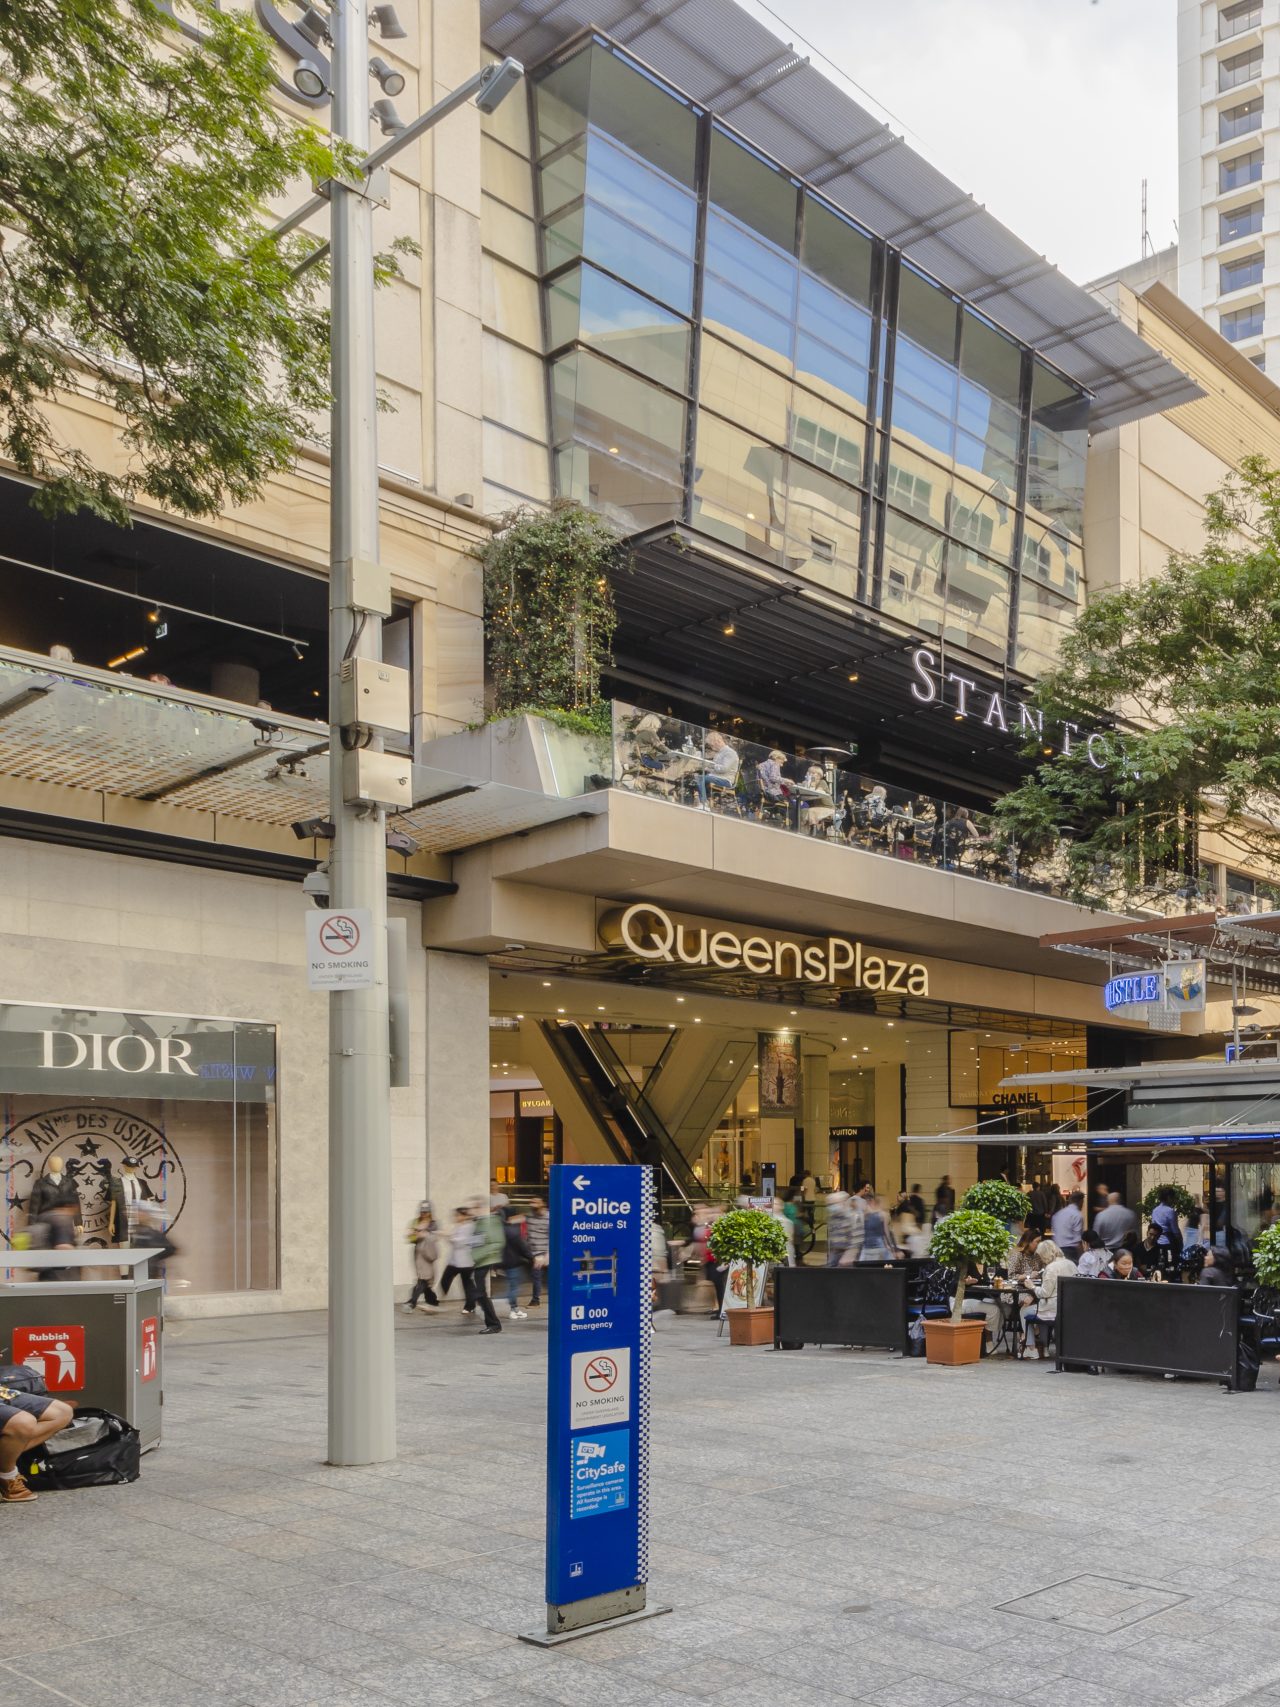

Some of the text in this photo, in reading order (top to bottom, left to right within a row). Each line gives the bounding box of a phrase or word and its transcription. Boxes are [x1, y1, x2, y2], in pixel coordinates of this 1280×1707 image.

[911, 650, 1141, 779] STANTO
[621, 903, 929, 996] QueensPlaza
[328, 961, 369, 969] SMOKING
[37, 1029, 199, 1076] DIOR
[992, 1092, 1043, 1105] CHANEL
[76, 1113, 108, 1129] DES
[113, 1117, 176, 1180] USINES
[572, 1198, 631, 1215] Police
[572, 1220, 627, 1230] Adelaide St
[572, 1234, 596, 1243] 300m
[588, 1308, 609, 1319] 000
[571, 1321, 613, 1331] Emergency
[28, 1332, 70, 1341] Rubbish
[576, 1395, 625, 1408] NO SMOKING
[576, 1460, 626, 1480] CitySafe
